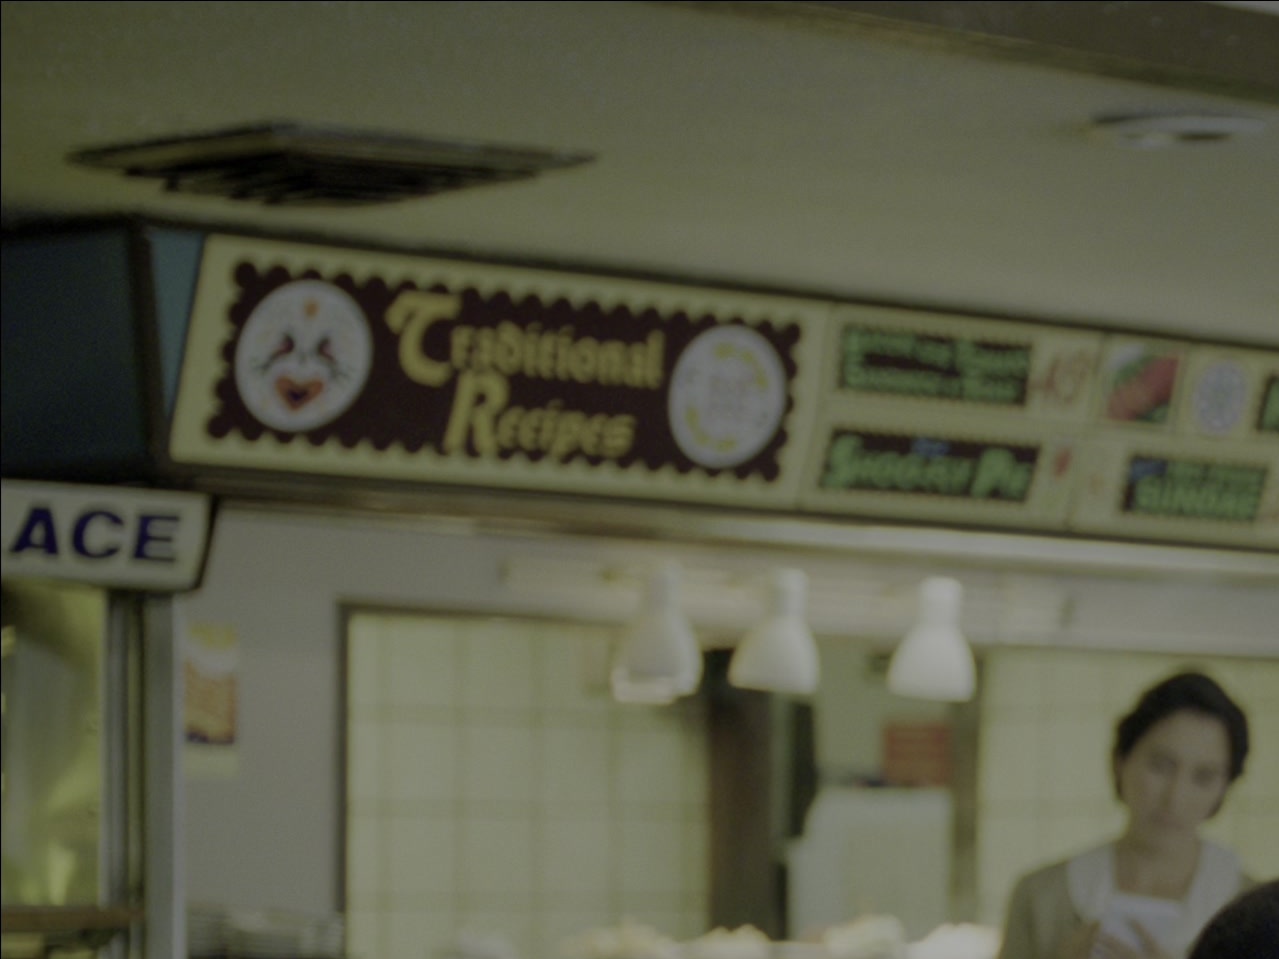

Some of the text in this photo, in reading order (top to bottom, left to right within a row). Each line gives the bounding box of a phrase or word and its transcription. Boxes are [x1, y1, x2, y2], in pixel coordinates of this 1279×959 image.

[383, 289, 666, 389] Traditional
[442, 369, 637, 459] Recipes
[9, 506, 184, 564] ACE
